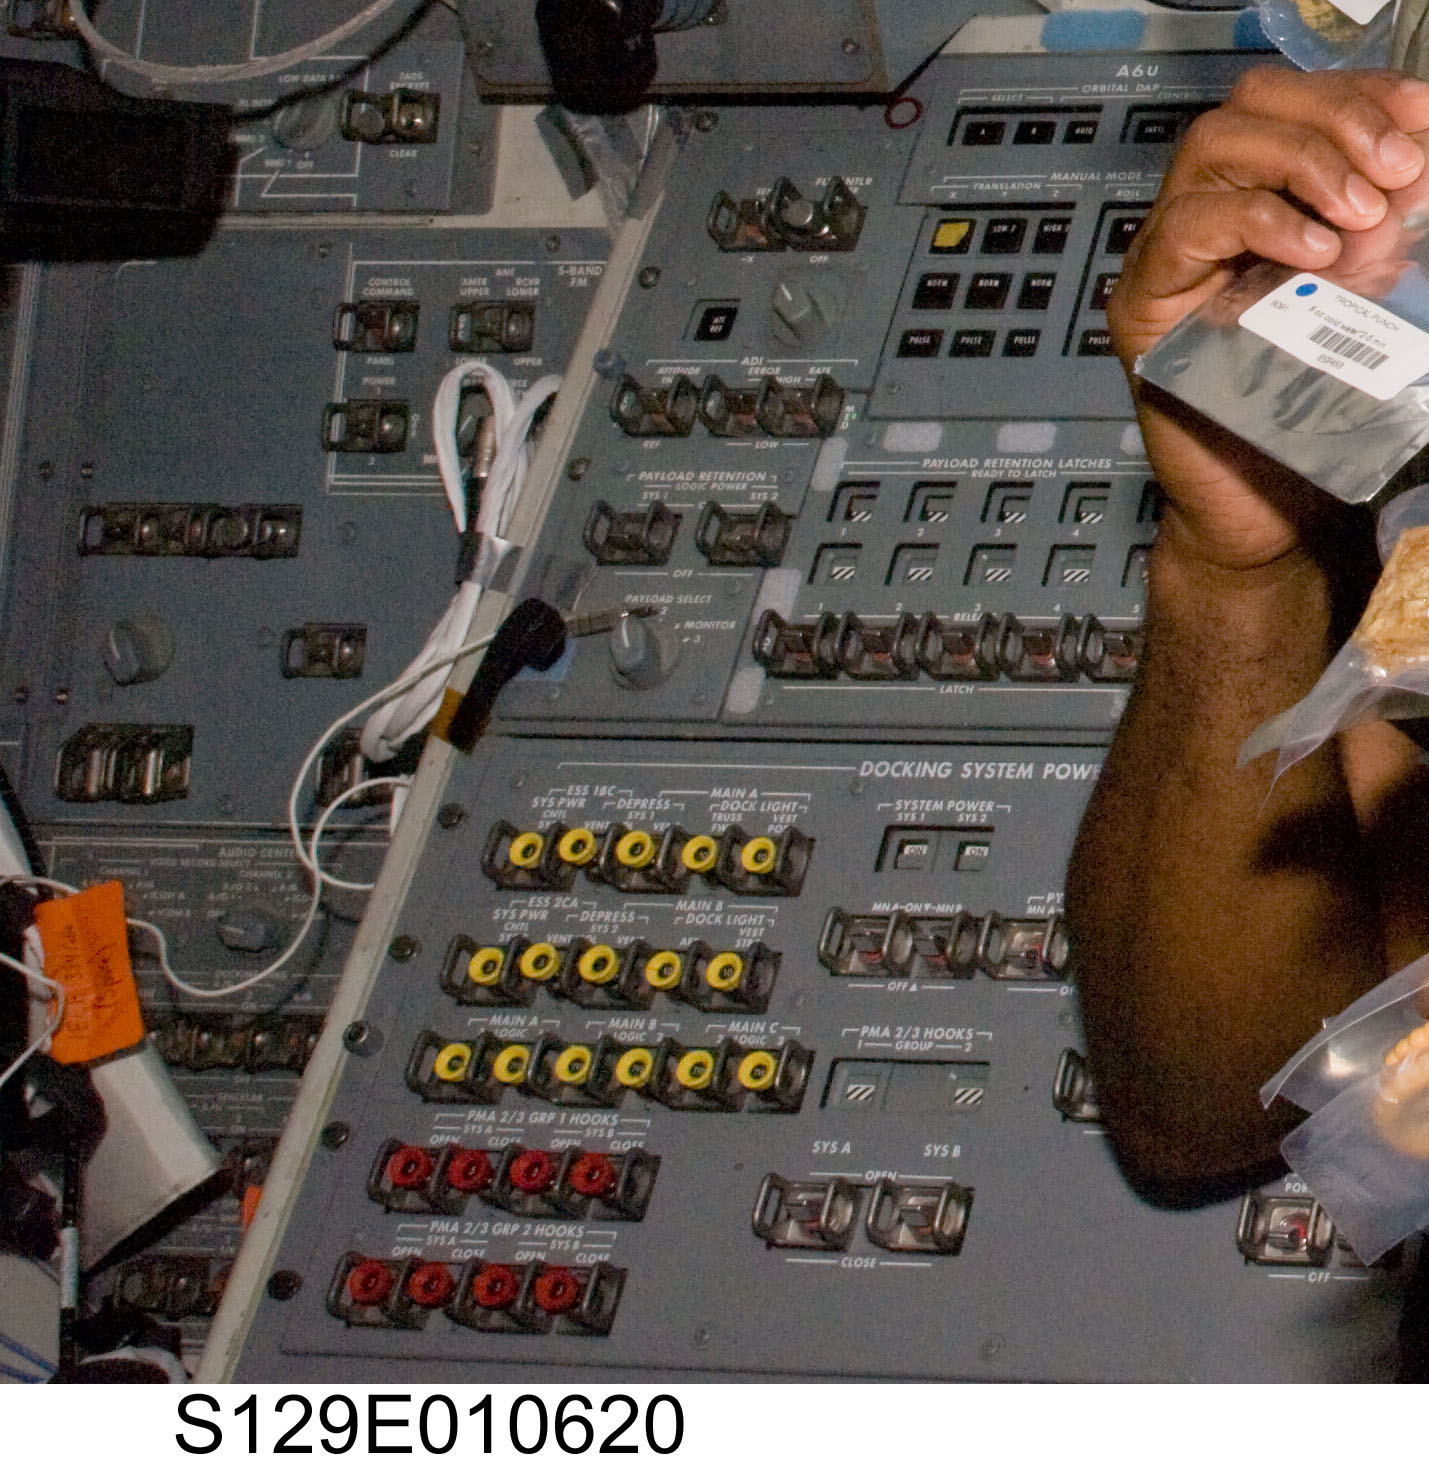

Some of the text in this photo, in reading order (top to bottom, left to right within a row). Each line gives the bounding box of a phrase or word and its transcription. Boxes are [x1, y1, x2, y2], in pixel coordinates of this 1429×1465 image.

[1116, 64, 1160, 78] A6U
[1082, 84, 1130, 94] ORBITAL
[1050, 171, 1143, 182] MANUAL MODE
[973, 182, 1041, 191] TRANSLATION
[558, 266, 603, 276] S-BAND
[362, 287, 414, 296] COMMAND
[1334, 294, 1400, 333] TROPICAL PUNCH
[923, 457, 1112, 470] PAYLOAD RETENTION LATCHES
[638, 472, 766, 482] PAYLOAD RETENTION
[971, 469, 1057, 479] READY TO LATCH
[625, 593, 712, 605] PAYLOAD SELECT
[940, 684, 974, 695] LATCH
[860, 761, 953, 778] DOCKING
[961, 762, 1033, 779] SYSTEM
[711, 788, 746, 799] MAIN
[616, 798, 671, 810] DEPRESS
[719, 801, 800, 813] DOCK LIGHT
[894, 801, 995, 811] SYSTEM POWER
[553, 897, 579, 908] 2CA
[675, 900, 713, 912] MAIN
[580, 911, 636, 923] DEPRESS
[685, 913, 766, 926] DOCK LIGHT
[860, 1026, 974, 1041] PMA 2/3 HOOKS
[467, 1110, 619, 1126] PMA GRP HOOKS
[429, 1222, 585, 1238] PMA GRP HOOKS
[841, 1257, 878, 1268] CLOSE
